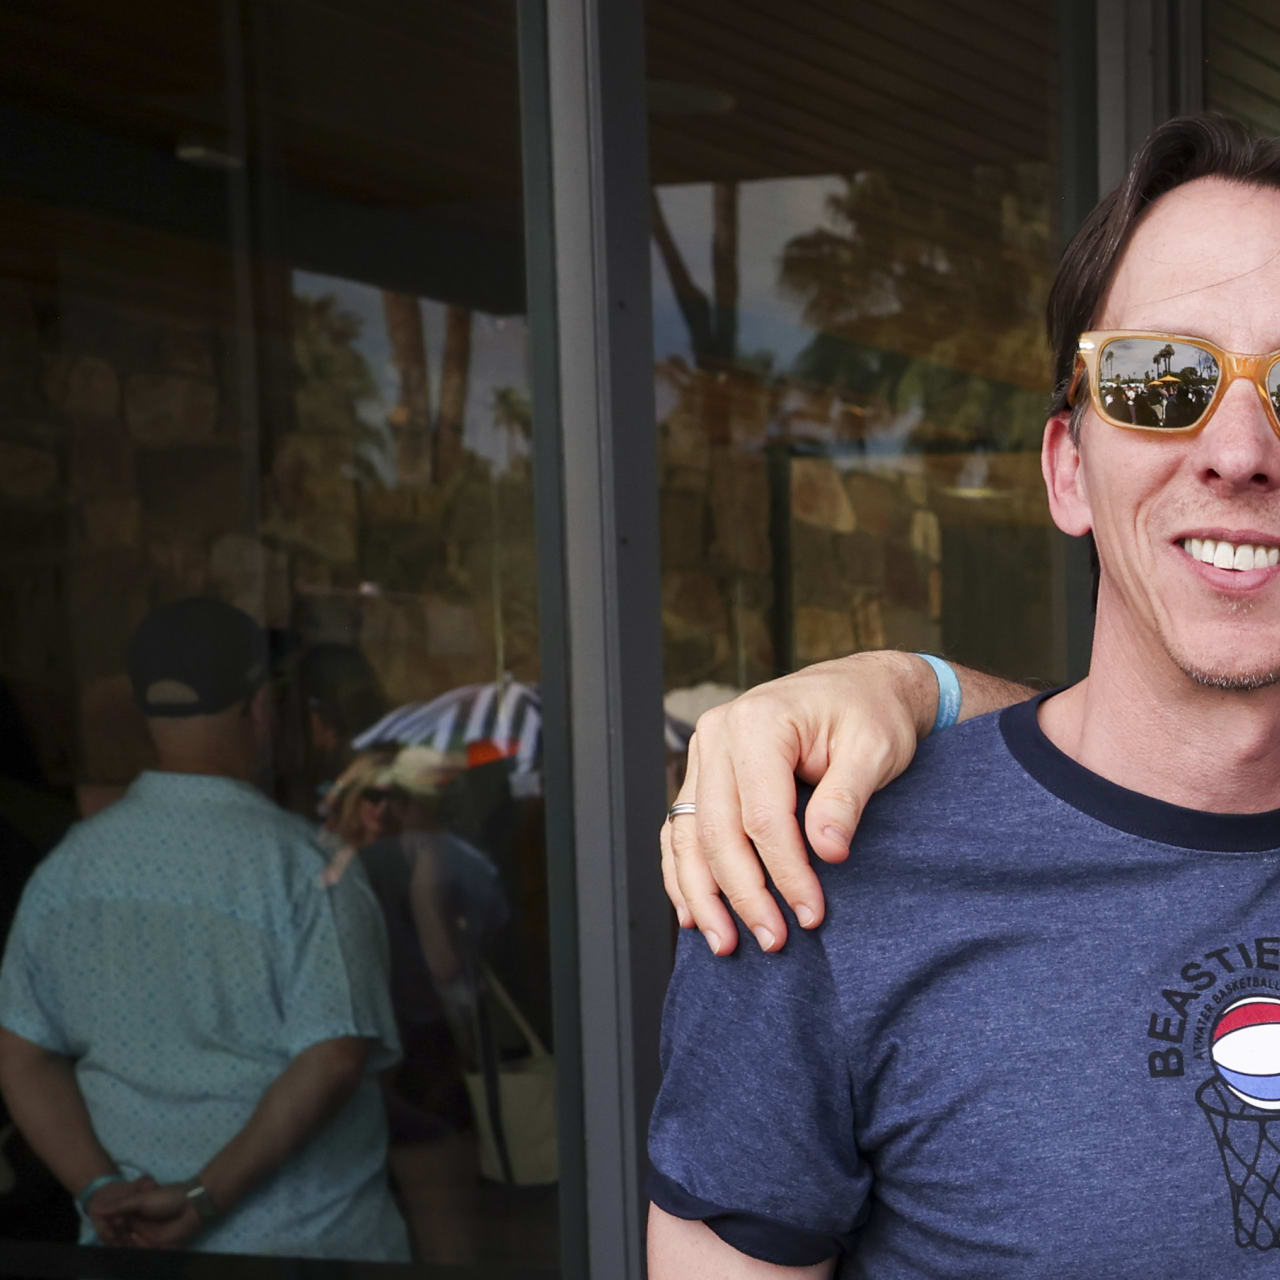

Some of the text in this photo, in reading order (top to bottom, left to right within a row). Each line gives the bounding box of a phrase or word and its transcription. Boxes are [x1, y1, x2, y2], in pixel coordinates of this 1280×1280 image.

[1148, 937, 1280, 1078] BEASTIE
[1192, 1003, 1216, 1060] ATWATER
[1212, 976, 1280, 1003] BASKETBALL
